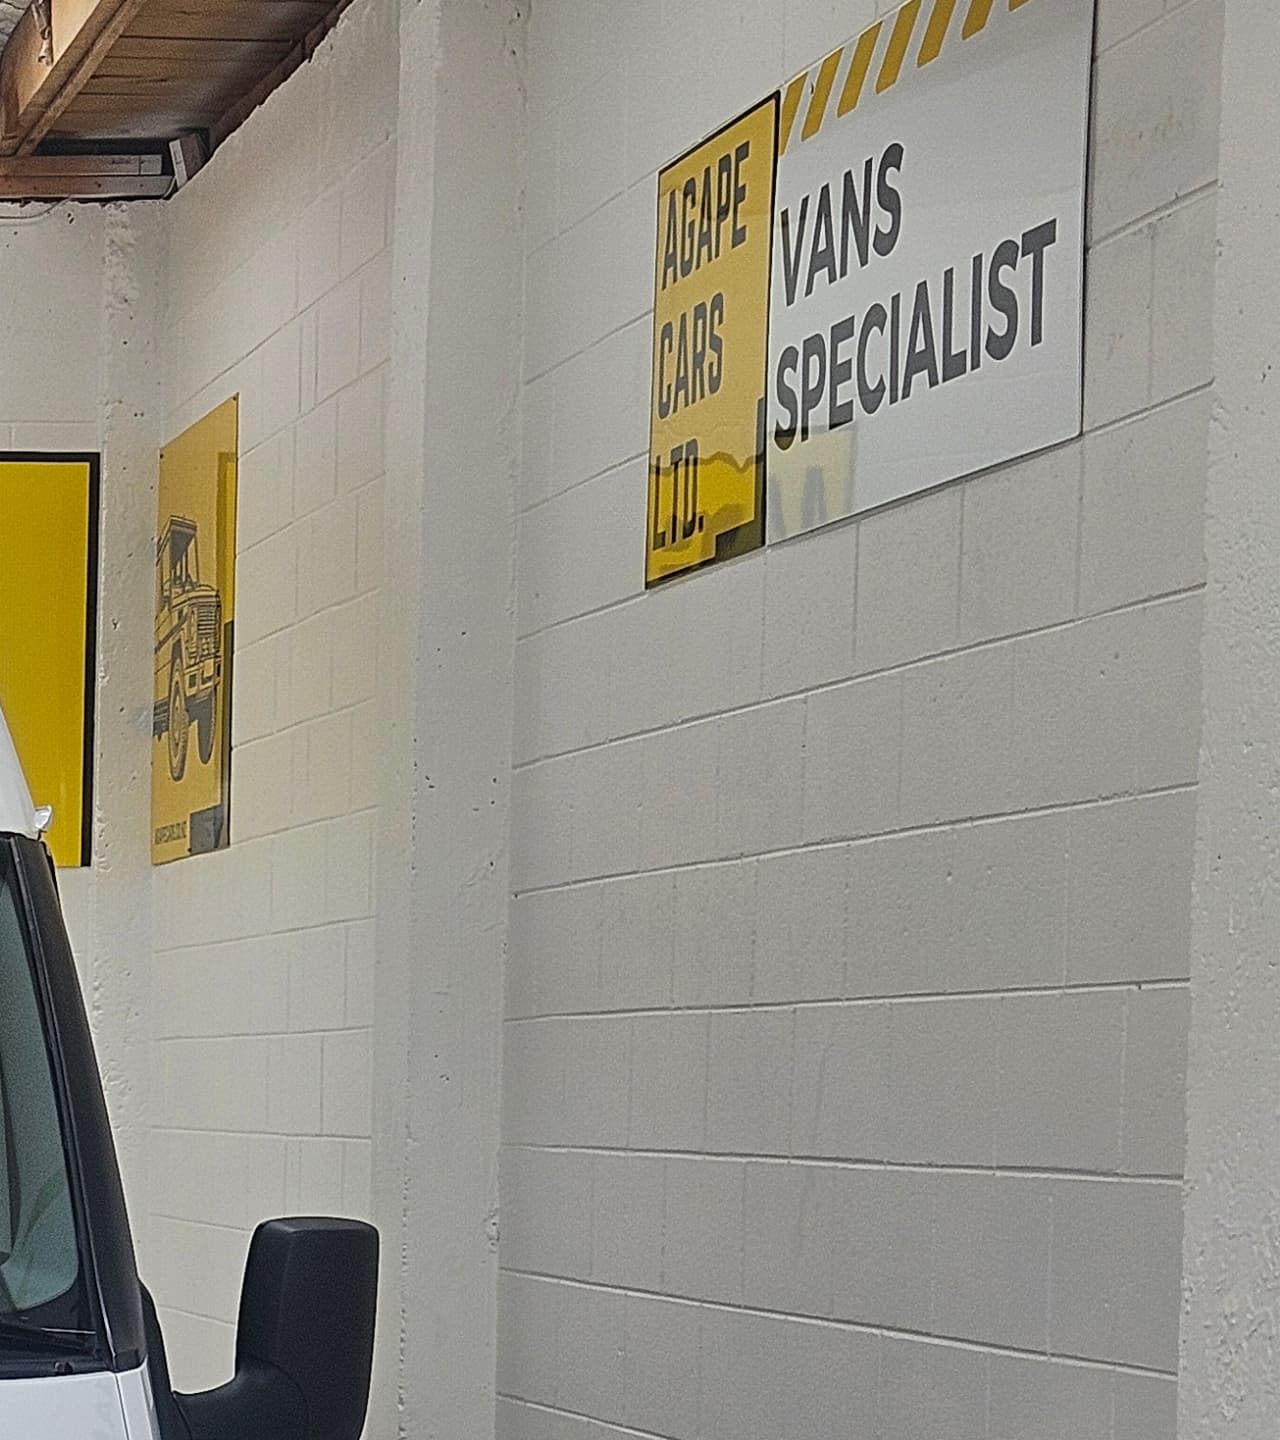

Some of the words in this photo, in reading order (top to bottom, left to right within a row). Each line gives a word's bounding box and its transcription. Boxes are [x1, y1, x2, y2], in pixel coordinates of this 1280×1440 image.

[662, 140, 750, 291] AGAPE
[780, 142, 904, 307] VANS
[657, 292, 724, 420] CARS
[774, 217, 1058, 451] SPECIALIST
[652, 437, 705, 552] LTD.
